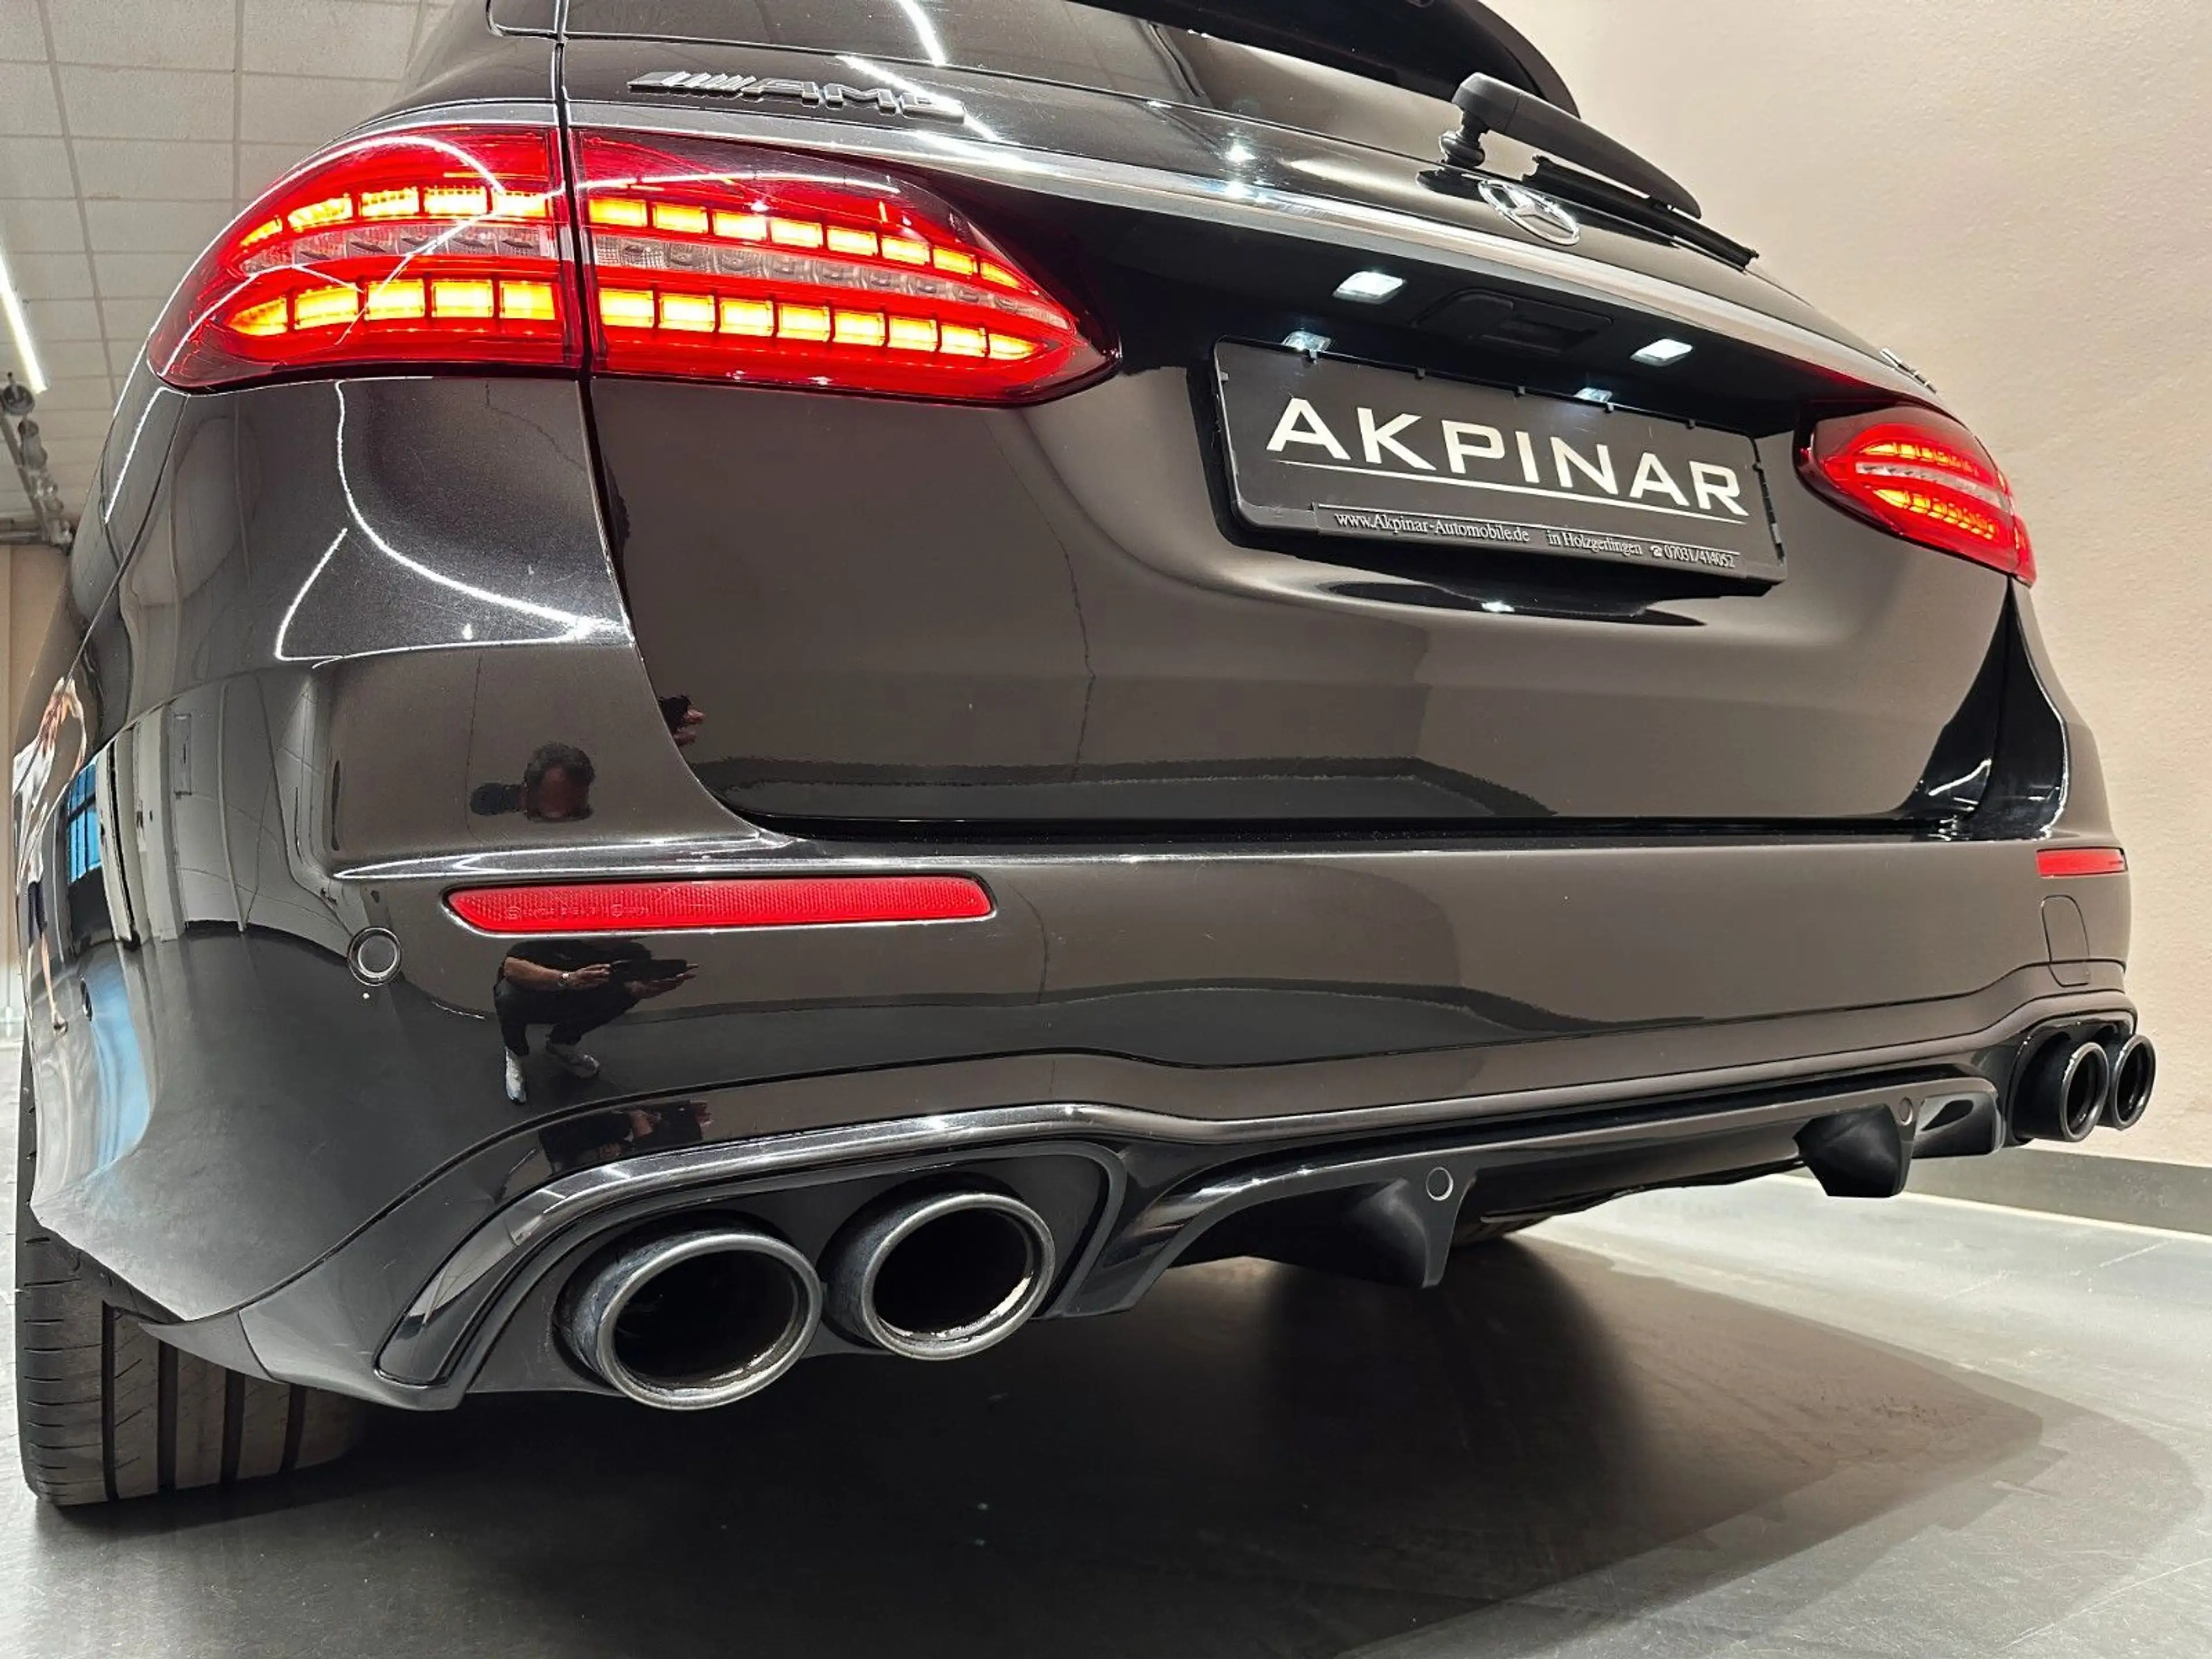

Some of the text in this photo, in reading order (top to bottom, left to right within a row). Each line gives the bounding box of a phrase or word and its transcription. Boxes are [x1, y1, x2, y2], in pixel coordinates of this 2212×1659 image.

[1266, 397, 1749, 517] AKPINAR
[1334, 513, 1530, 541] www.Akpinar-Automobile.de
[1547, 529, 1561, 547] in
